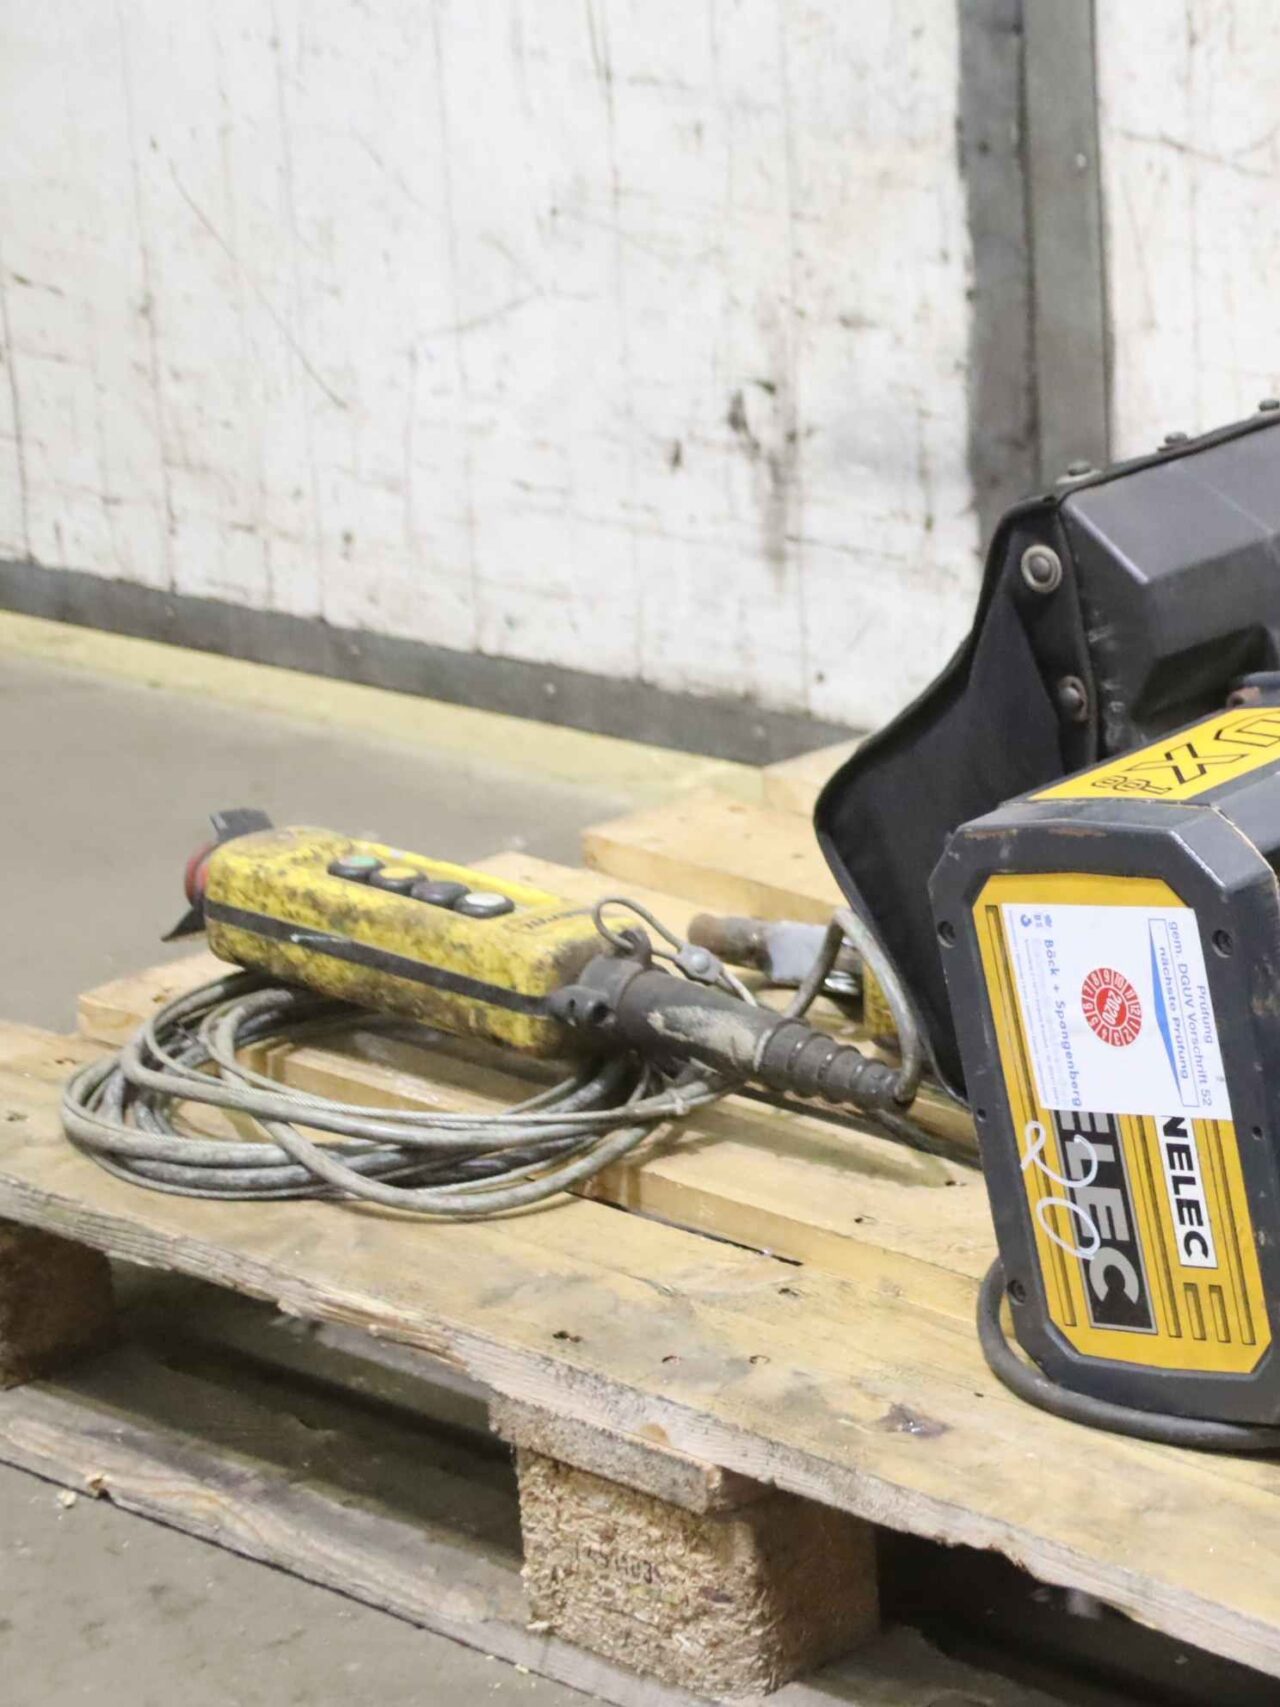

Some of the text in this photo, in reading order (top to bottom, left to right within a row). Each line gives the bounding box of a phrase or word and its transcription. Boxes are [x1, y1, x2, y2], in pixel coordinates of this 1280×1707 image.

[1044, 939, 1060, 976] Böck
[1055, 1000, 1082, 1107] Spangenberg
[1102, 990, 1122, 1025] 2020
[1160, 946, 1189, 1080] nächste Prüfung
[1178, 963, 1193, 1011] DGUV
[1188, 1012, 1208, 1084] Vorschrift
[1200, 1089, 1212, 1107] 52
[1197, 985, 1213, 1044] Prüfung
